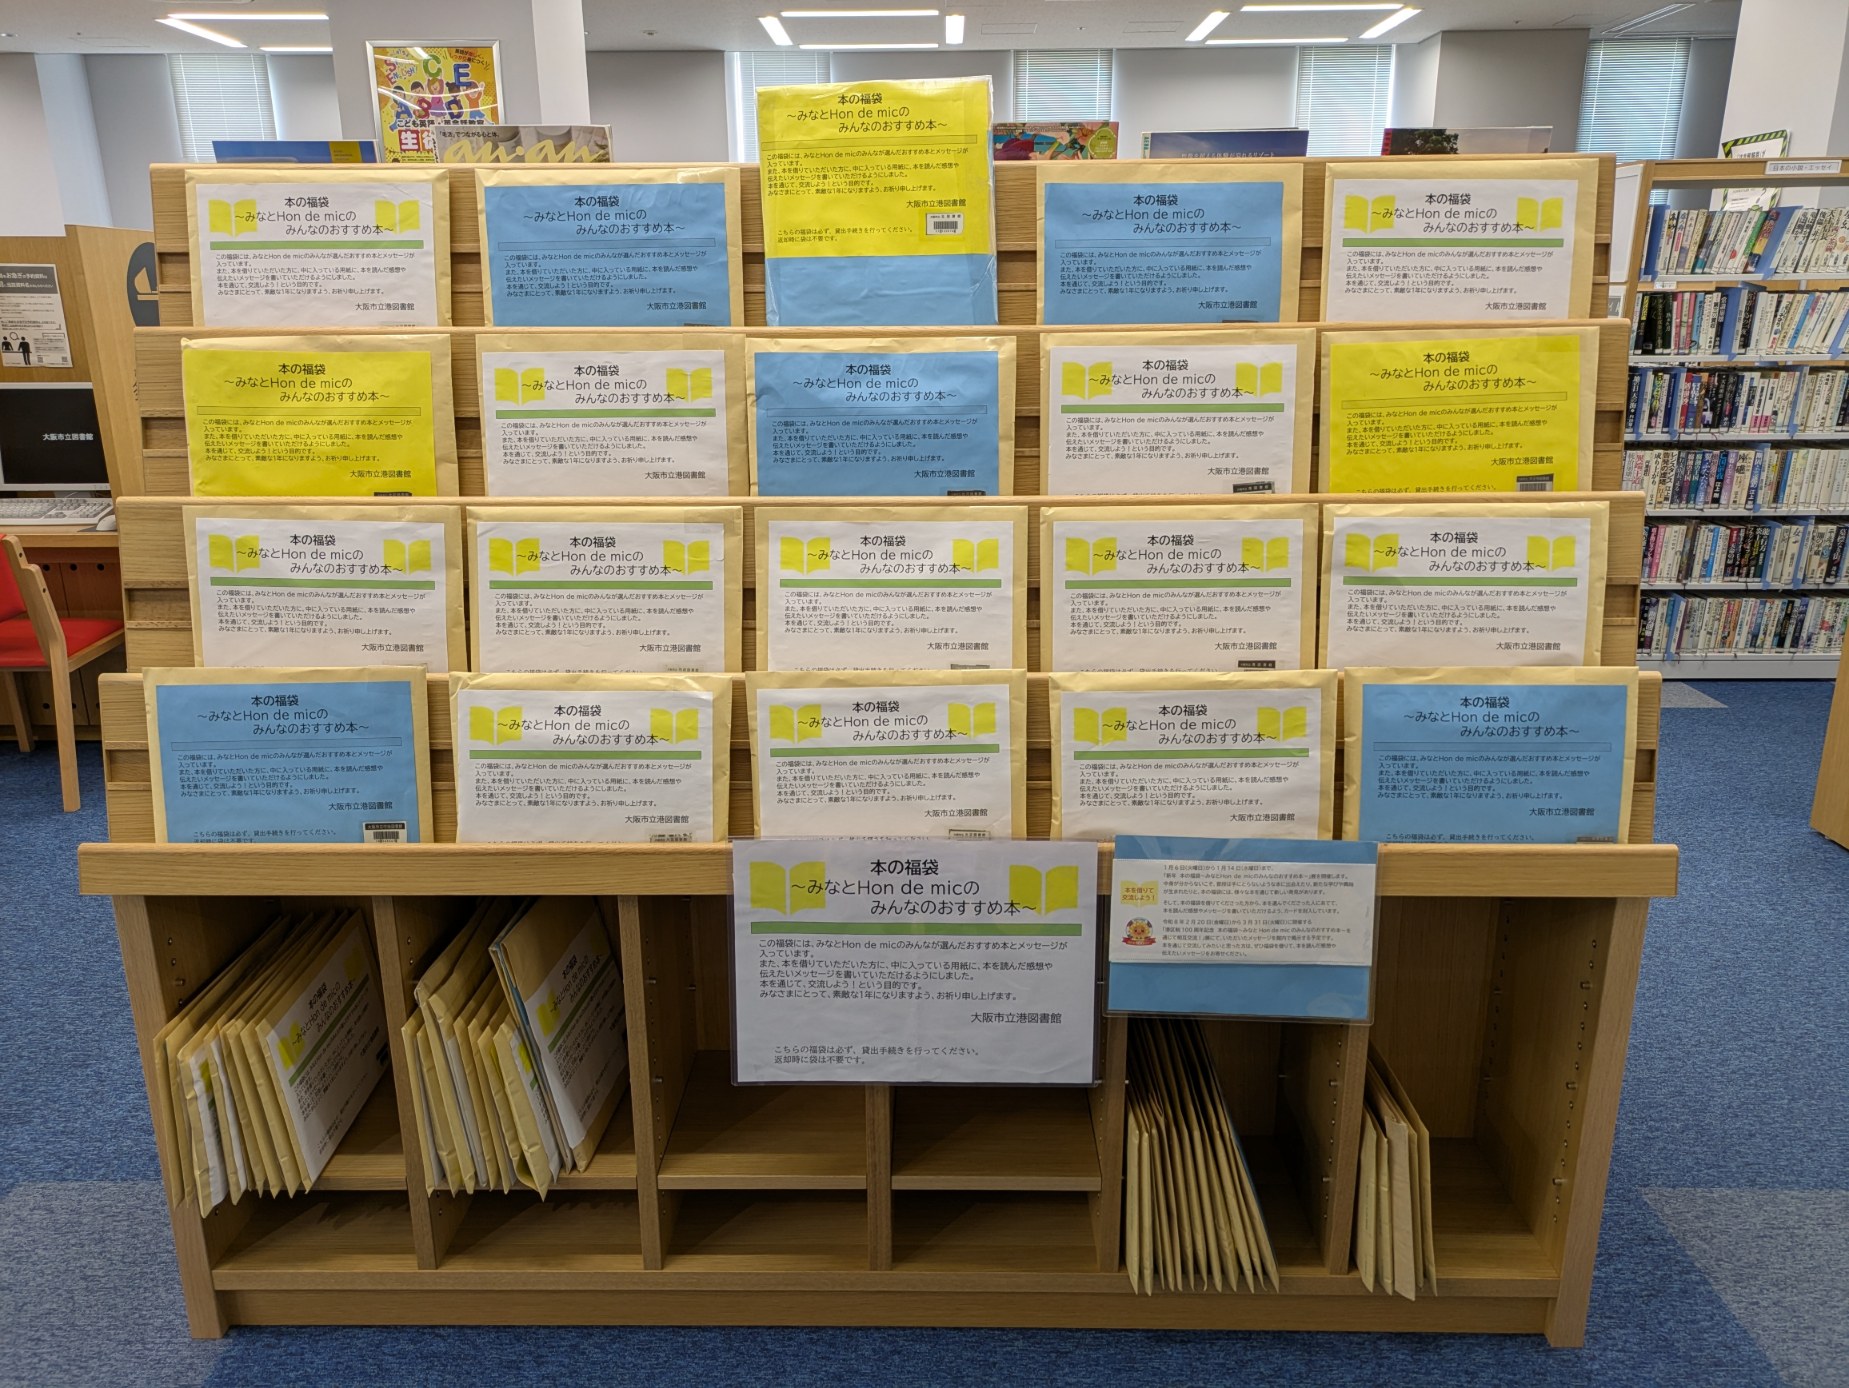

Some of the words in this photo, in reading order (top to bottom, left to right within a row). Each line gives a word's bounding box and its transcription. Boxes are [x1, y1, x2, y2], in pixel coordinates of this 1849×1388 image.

[837, 91, 882, 106] 本の福袋
[858, 107, 873, 118] de
[877, 107, 909, 118] micの
[284, 196, 329, 208] 本の福袋
[574, 195, 619, 208] 本の福袋
[907, 199, 966, 208] 大阪市立港図書館
[1133, 194, 1178, 206] 本の福袋
[1425, 193, 1470, 205] 本の福袋
[306, 210, 320, 221] de
[324, 211, 356, 221] micの
[595, 210, 610, 221] de
[615, 209, 647, 220] micの
[1153, 209, 1168, 219] de
[1173, 209, 1204, 219] micの
[1444, 208, 1459, 219] de
[1464, 208, 1497, 219] micの
[647, 301, 706, 310] 大阪市立港図書館
[1198, 301, 1257, 309] 大阪市立港図書館
[1486, 302, 1546, 310] 大阪市立港図書館
[1423, 351, 1470, 364] 本の福袋
[278, 363, 325, 375] 本の福袋
[846, 364, 891, 376] 本の福袋
[1143, 359, 1188, 371] 本の福袋
[574, 365, 619, 377] 本の福袋
[1444, 366, 1459, 377] de
[1464, 365, 1497, 376] micの
[300, 377, 316, 388] de
[321, 378, 352, 388] micの
[866, 378, 881, 388] de
[886, 378, 918, 388] micの
[1163, 373, 1178, 384] de
[1183, 373, 1216, 384] micの
[595, 379, 609, 390] de
[615, 379, 646, 390] micの
[42, 433, 93, 441] 大阪市立図書館
[1491, 456, 1553, 465] 大阪市立港図書館
[350, 470, 411, 478] 大阪市立港図書館
[645, 471, 705, 479] 大阪市立港図書館
[914, 469, 975, 478] 大阪市立港図書館
[1208, 467, 1269, 475] 大阪市立港図書館
[290, 534, 335, 546] 本の福袋
[570, 536, 615, 548] 本の福袋
[860, 535, 906, 547] 本の福袋
[1148, 534, 1194, 546] 本の福袋
[1430, 532, 1478, 543] 本の福袋
[311, 549, 325, 560] de
[331, 549, 363, 560] micの
[591, 551, 605, 561] de
[611, 551, 643, 561] micの
[881, 549, 896, 560] de
[901, 550, 933, 560] micの
[1169, 549, 1183, 560] de
[1188, 549, 1221, 559] micの
[1452, 546, 1467, 557] de
[1472, 547, 1506, 557] micの
[362, 643, 424, 652] 大阪市立港図書館
[640, 644, 701, 652] 大阪市立港図書館
[928, 642, 989, 650] 大阪市立港図書館
[1215, 642, 1277, 650] 大阪市立港図書館
[1496, 642, 1561, 650] 大阪市立港図書館
[251, 694, 299, 707] 本の福袋
[1460, 696, 1510, 708] 本の福袋
[554, 705, 601, 717] 本の福袋
[853, 700, 900, 713] 本の福袋
[1158, 704, 1207, 717] 本の福袋
[273, 709, 289, 720] de
[294, 709, 328, 720] micの
[1482, 711, 1499, 722] de
[1504, 711, 1539, 722] micの
[576, 720, 590, 730] de
[596, 720, 629, 730] micの
[875, 715, 889, 726] de
[895, 715, 928, 726] micの
[1180, 719, 1196, 730] de
[1202, 719, 1236, 730] micの
[329, 801, 392, 811] 大阪市立港図書館
[925, 809, 988, 817] 大阪市立港図書館
[1230, 813, 1295, 822] 大阪市立港図書館
[1529, 808, 1595, 816] 大阪市立港図書館
[625, 815, 689, 823] 大阪市立港図書館
[870, 859, 939, 875] 本の福袋
[792, 880, 894, 895] ～みなとHon
[902, 880, 923, 895] de
[931, 880, 979, 896] micの
[871, 900, 1037, 916] みんなのおすすめ本～
[865, 940, 876, 949] de
[760, 950, 814, 958] 入っています。
[760, 970, 974, 980] 伝えたいメッセージを書いていただけるようにしました。
[971, 1012, 1062, 1024] 大阪市立港図書館
[774, 1056, 865, 1065] 返却時に袋は不要です。
